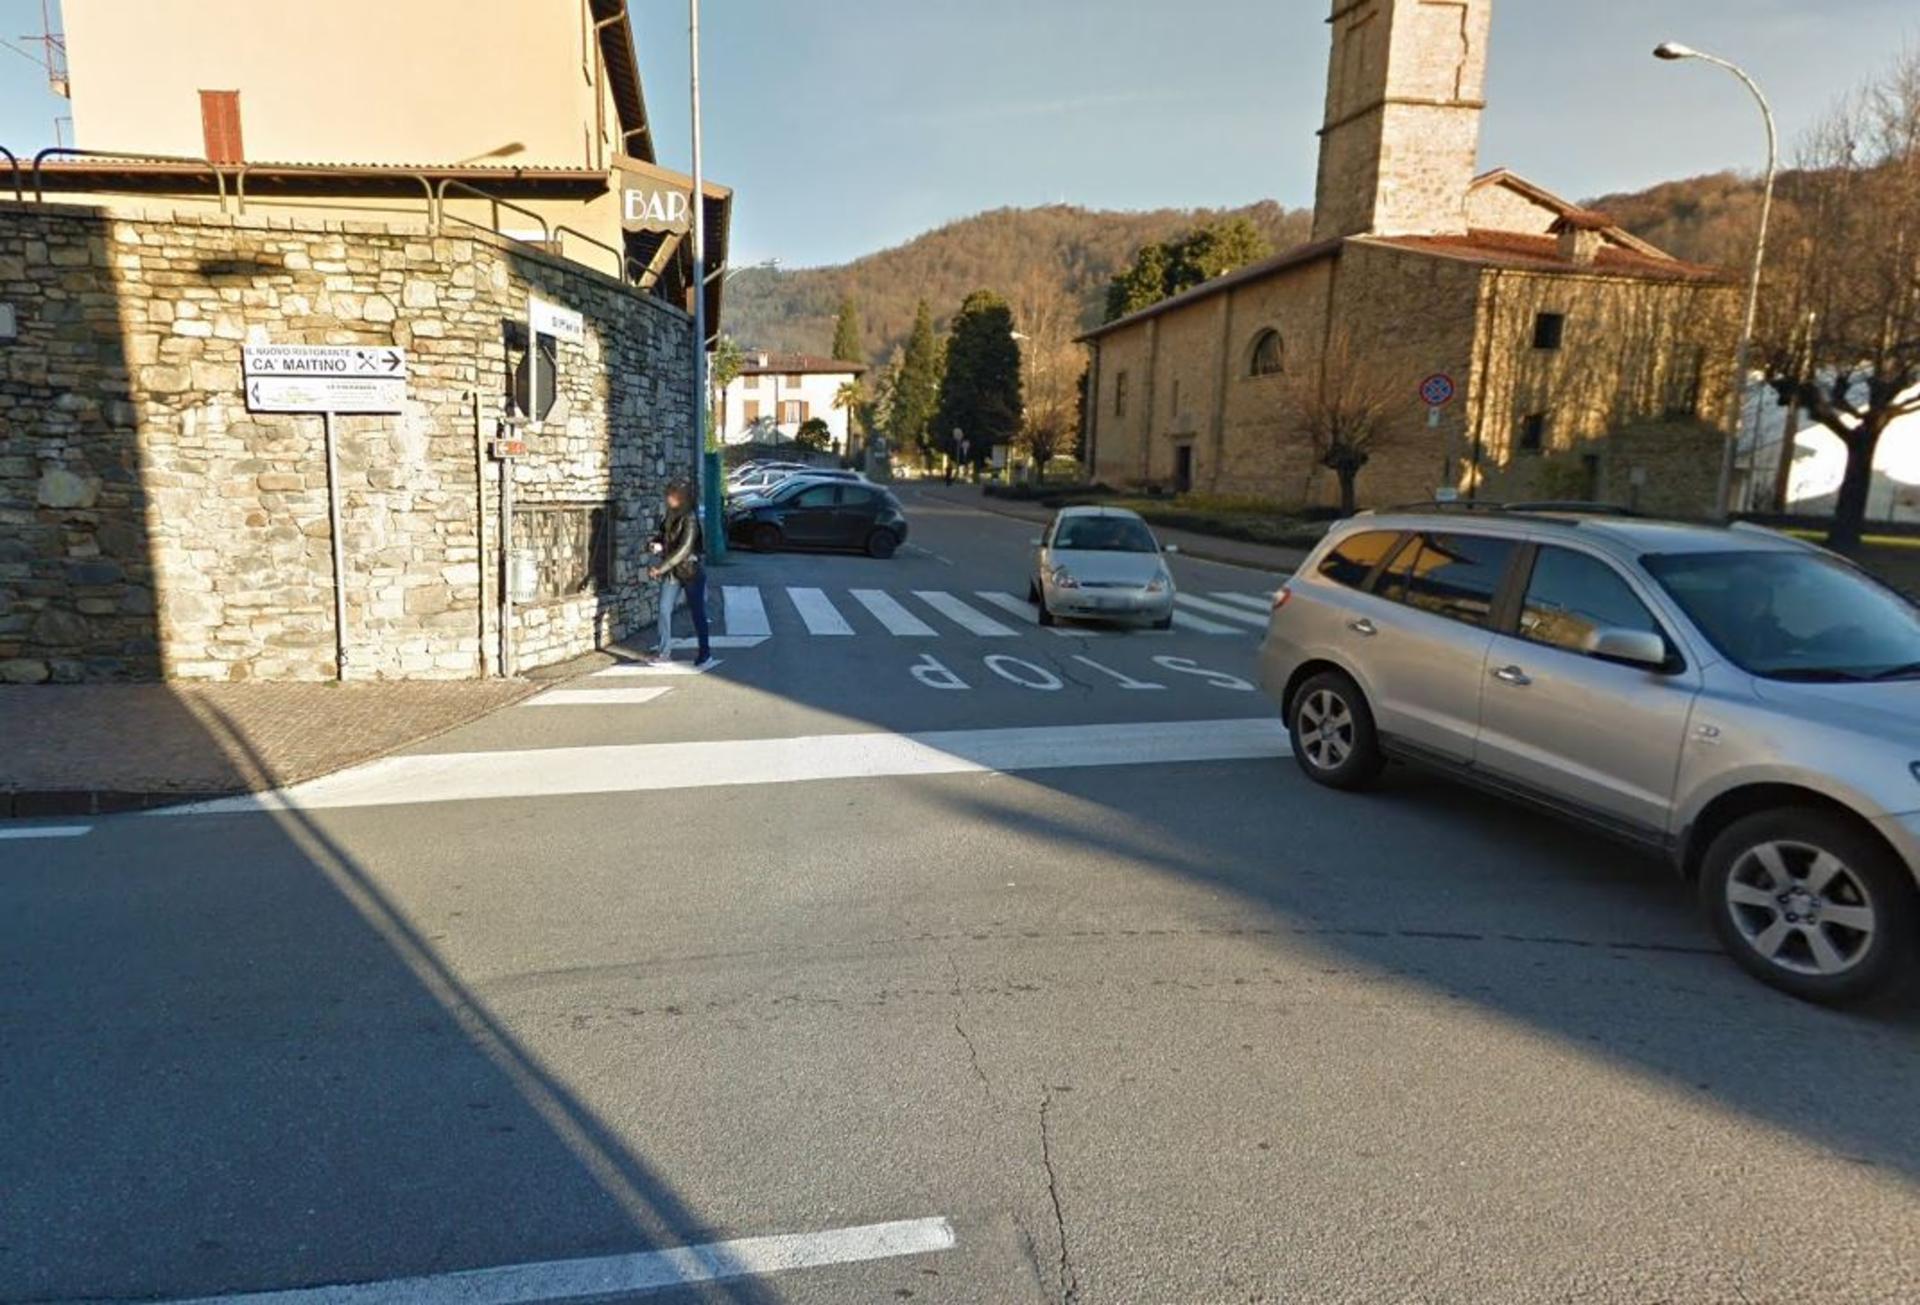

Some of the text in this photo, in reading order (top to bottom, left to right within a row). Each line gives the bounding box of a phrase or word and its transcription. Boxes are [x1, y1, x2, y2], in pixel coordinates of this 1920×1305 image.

[625, 189, 687, 223] BAR
[252, 358, 346, 372] CA' MAITINO
[909, 653, 1257, 691] STOP
